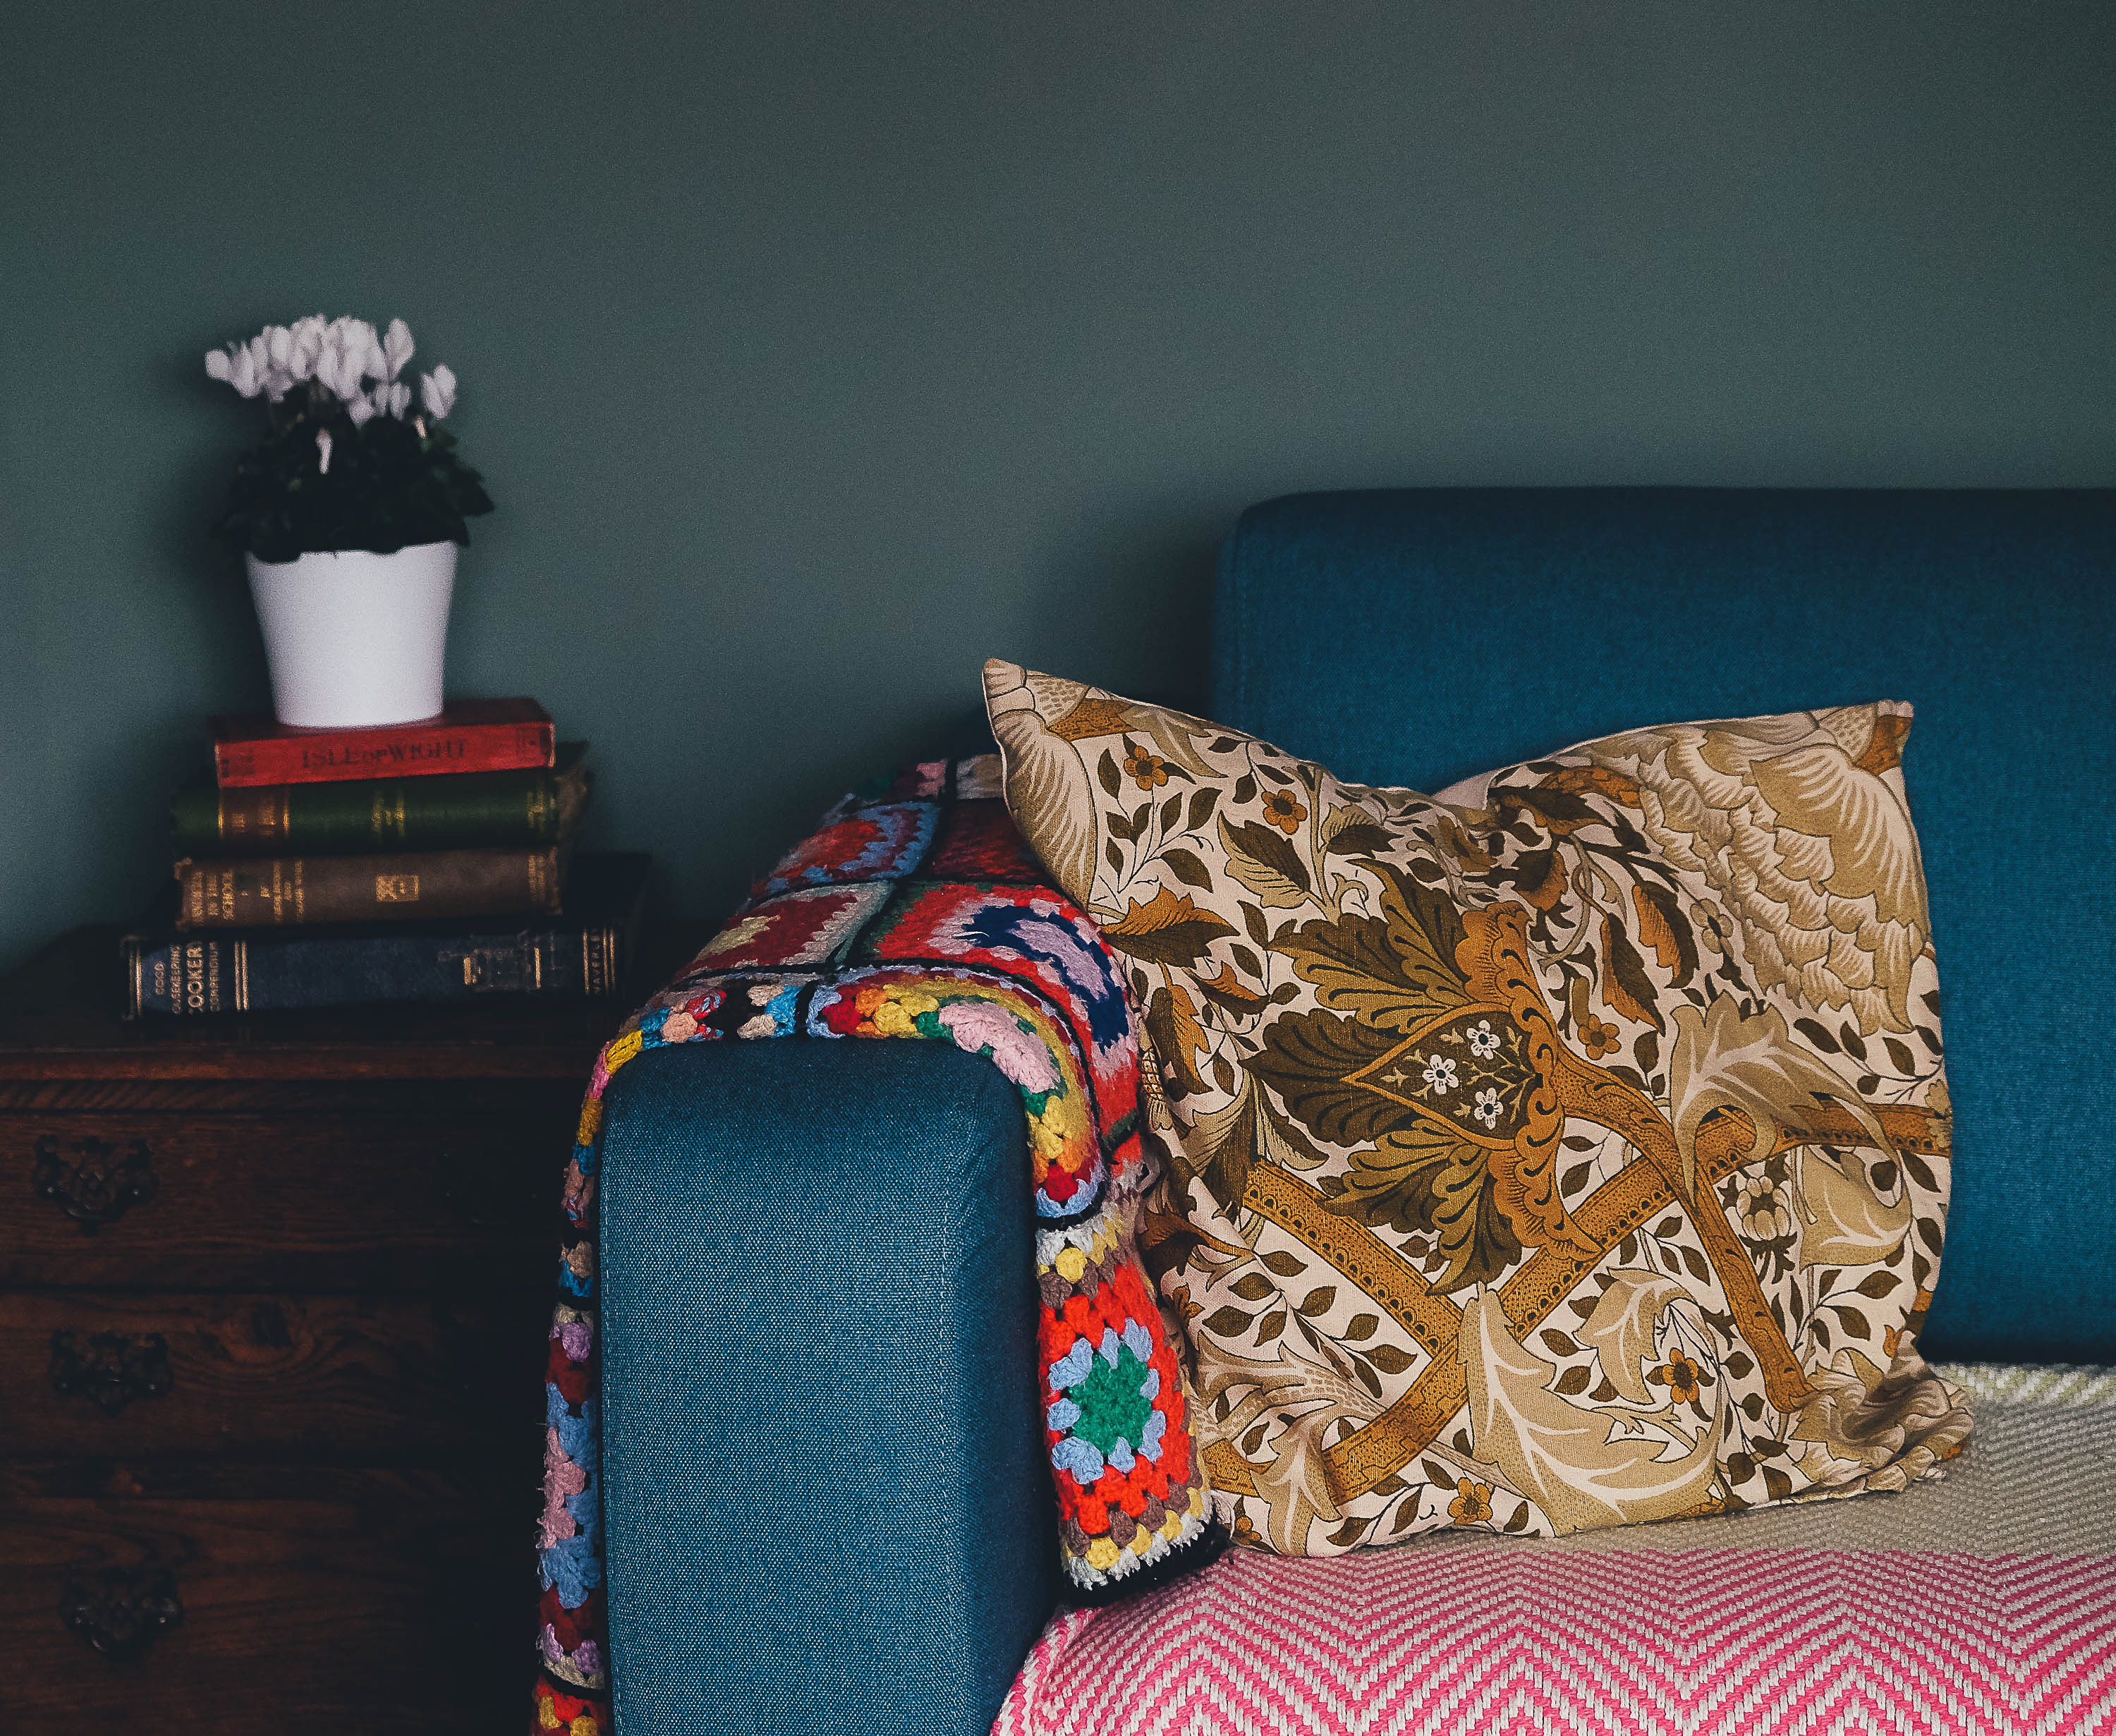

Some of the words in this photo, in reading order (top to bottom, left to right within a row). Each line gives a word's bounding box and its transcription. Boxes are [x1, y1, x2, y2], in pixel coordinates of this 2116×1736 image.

[302, 747, 359, 768] ISLE
[389, 739, 466, 761] WIGHT
[221, 870, 235, 921] SCHOOL
[169, 944, 181, 1015] OUSEKEEPING
